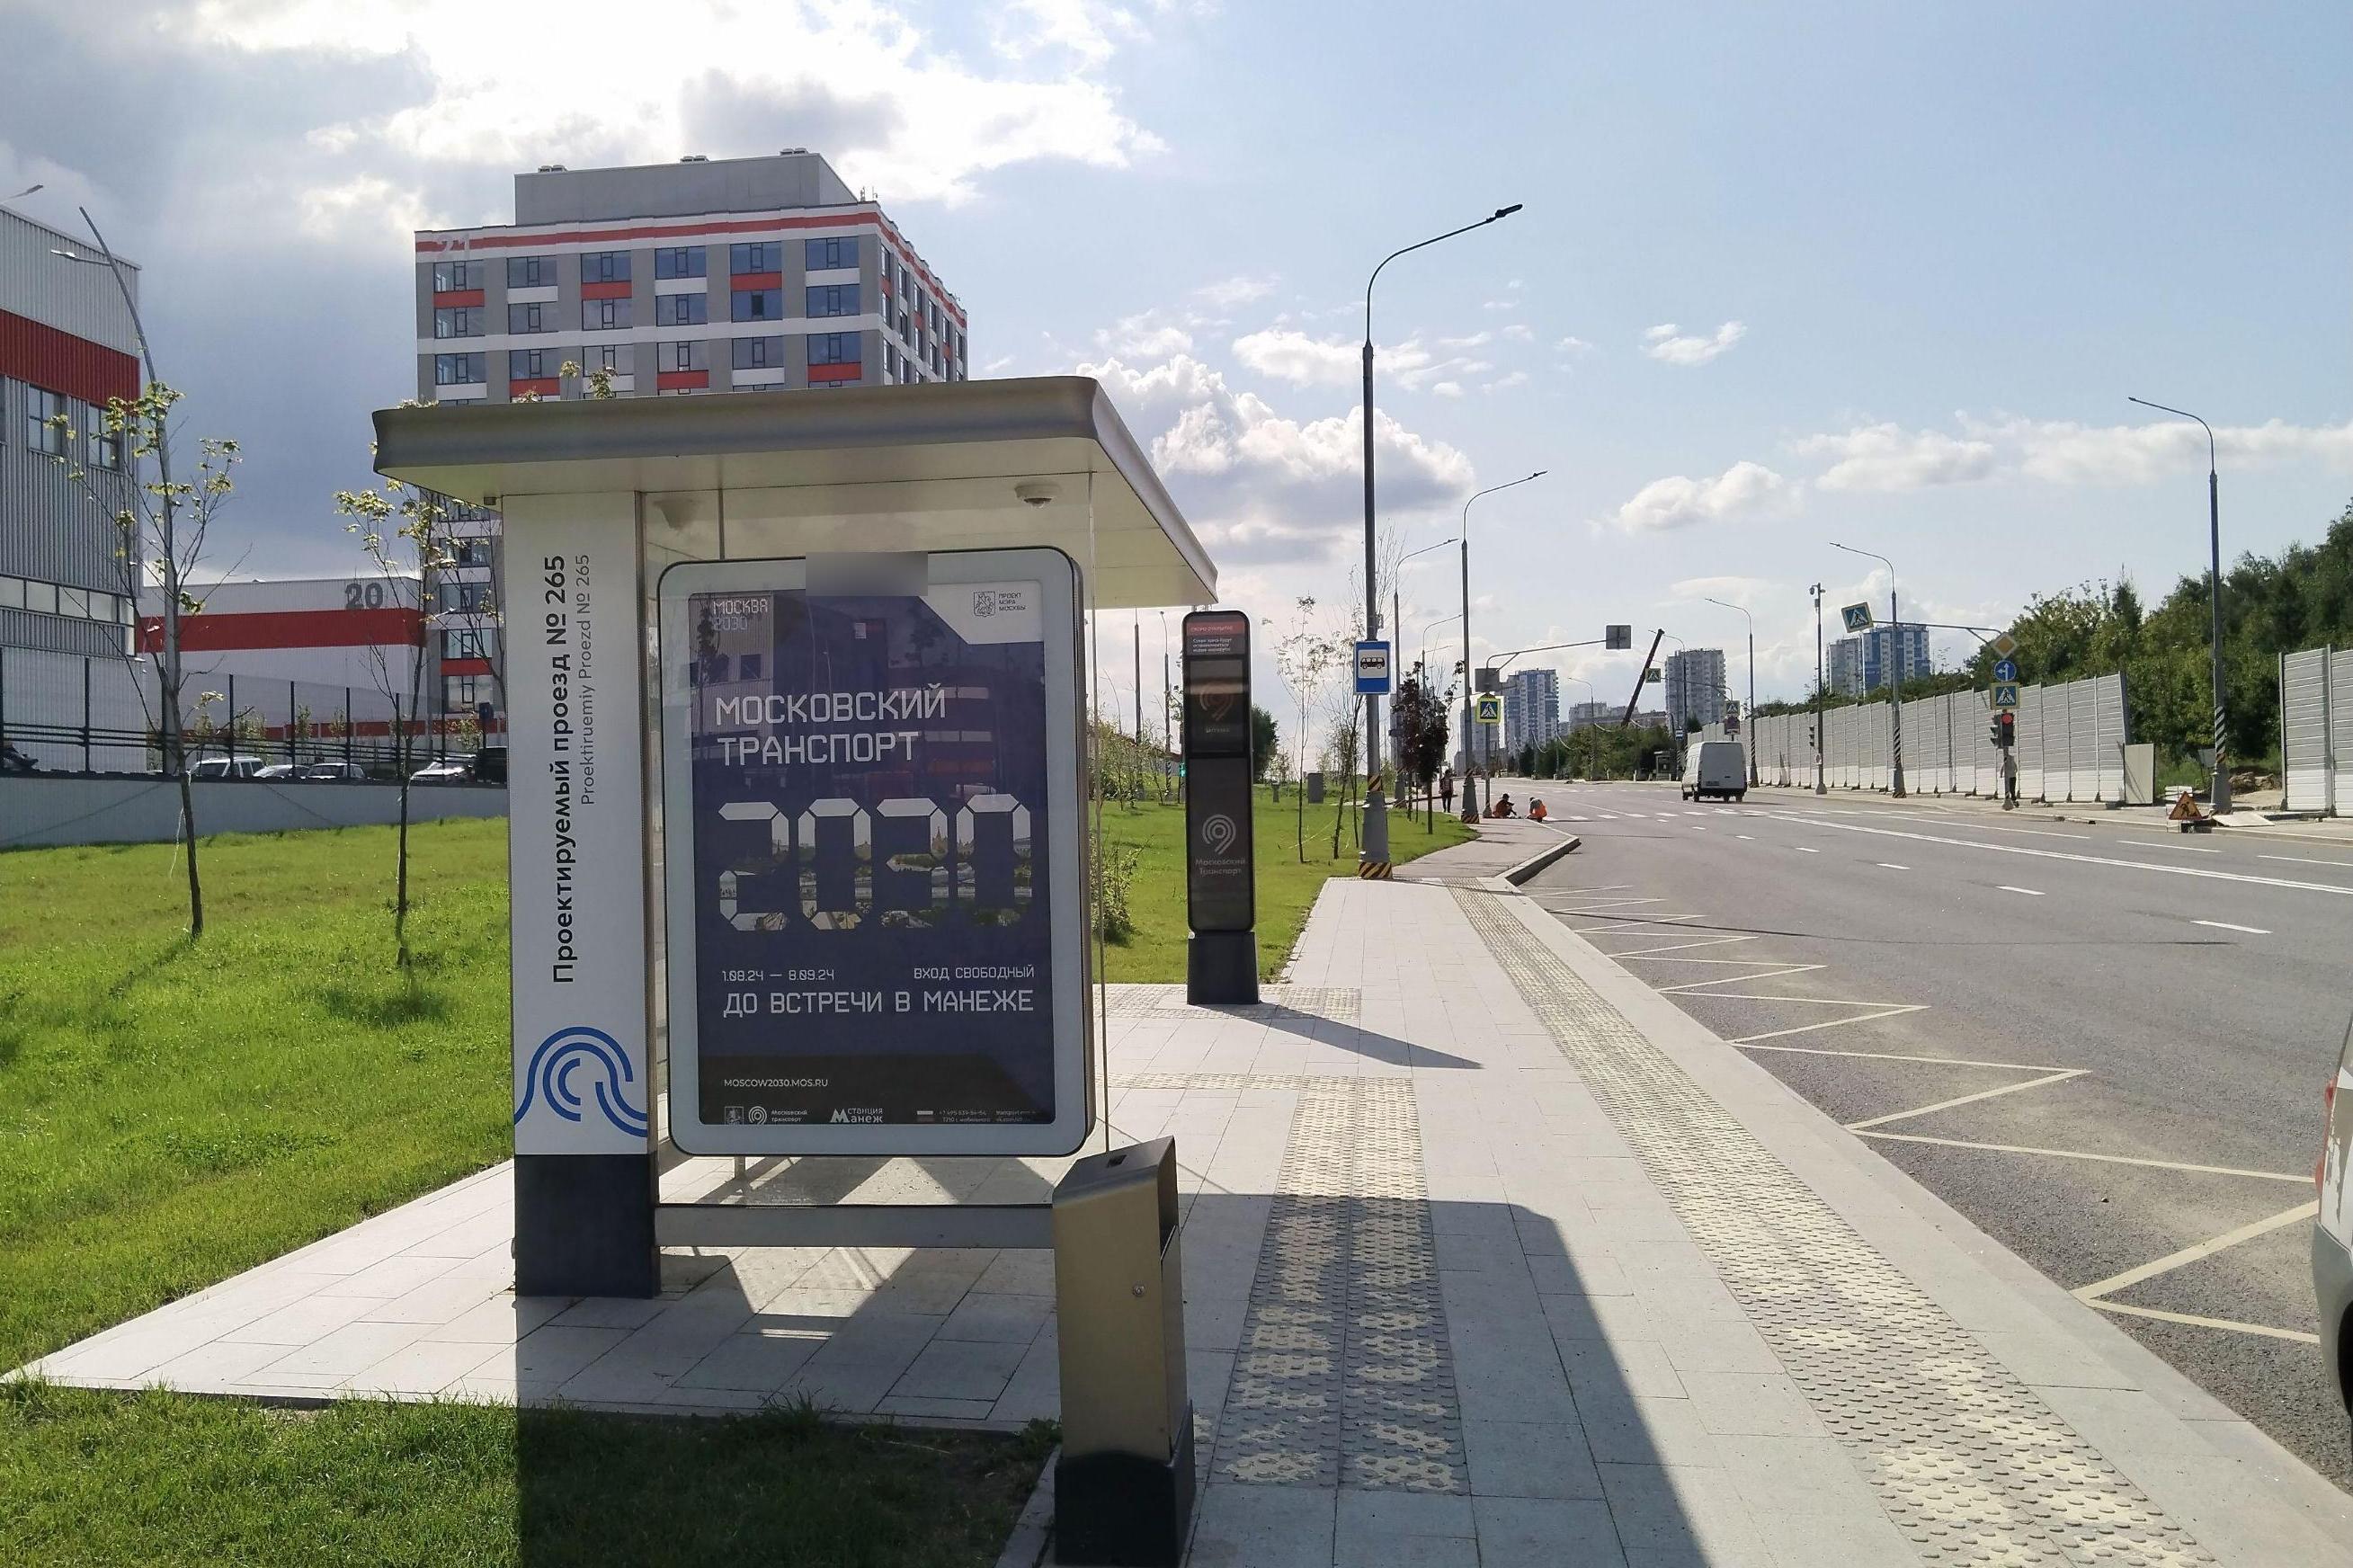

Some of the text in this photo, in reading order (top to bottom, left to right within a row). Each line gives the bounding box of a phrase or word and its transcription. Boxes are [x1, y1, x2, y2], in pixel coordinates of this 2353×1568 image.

[345, 583, 384, 610] 20
[713, 598, 768, 615] МОСКВА
[575, 555, 596, 805] Proektiruemiy Proezd № 265
[716, 683, 946, 726] МОСКОВСКИЙ
[717, 731, 920, 766] ТРАНСПОРТ
[545, 556, 577, 983] Проектируемый проезд № 265
[718, 793, 1034, 931] 2030
[722, 970, 764, 982] 1.08.24
[789, 969, 835, 981] 8.09.24
[914, 964, 1035, 981] ВХОД СВОБОДНЫЙ
[723, 990, 1034, 1018] ДО ВСТРЕЧИ В МАНЕЖЕ
[724, 1079, 829, 1088] MOSCOW2030.MOS.RU
